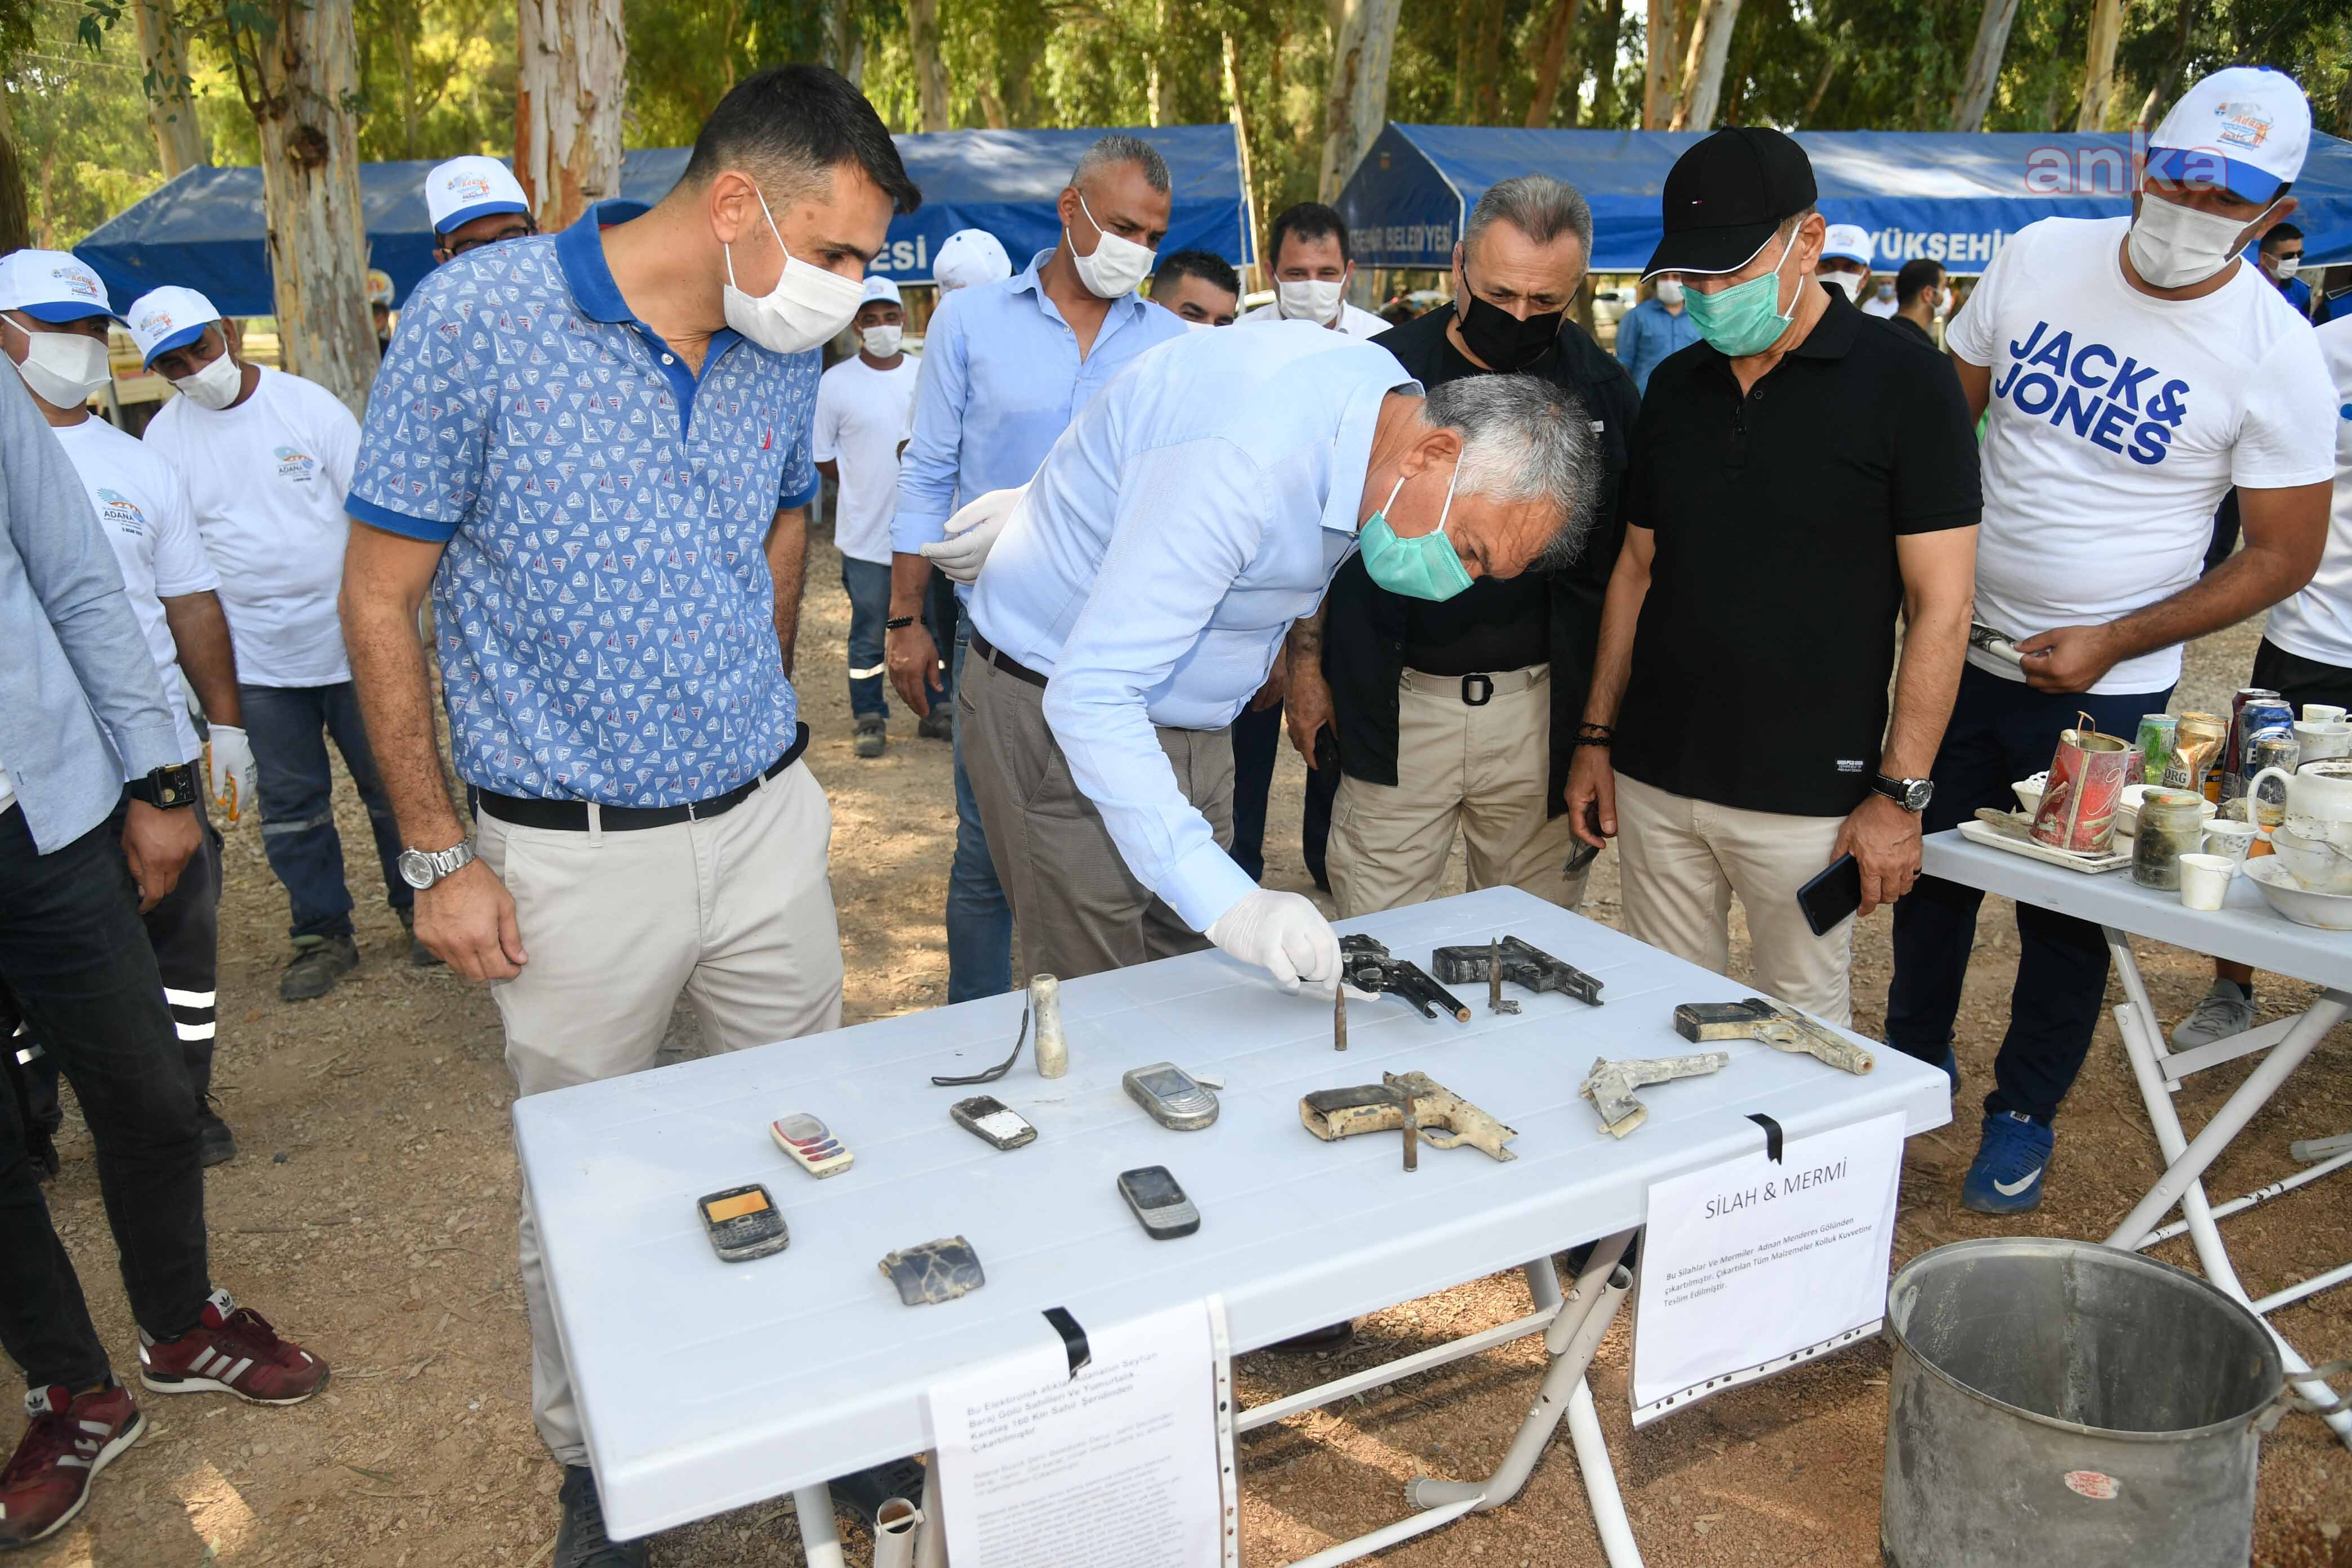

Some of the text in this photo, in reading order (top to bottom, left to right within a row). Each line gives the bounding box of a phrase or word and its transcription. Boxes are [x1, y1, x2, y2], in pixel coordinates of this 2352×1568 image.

[1995, 362, 2171, 465] JONES
[1705, 1156, 1847, 1219] SİLAH & MERMİ
[1678, 1263, 1706, 1277] Silahlar
[1720, 1248, 1754, 1264] Mermiler
[1757, 1240, 1781, 1252] Adnan
[1783, 1228, 1819, 1245] Menderes
[1820, 1217, 1854, 1233] Gölünden
[1716, 1262, 1752, 1279] Çıkartılan
[1753, 1256, 1769, 1266] Tüm
[1815, 1234, 1837, 1248] Kolluk
[1838, 1224, 1873, 1240] Kuvvetine
[1664, 1293, 1689, 1307] Teslim
